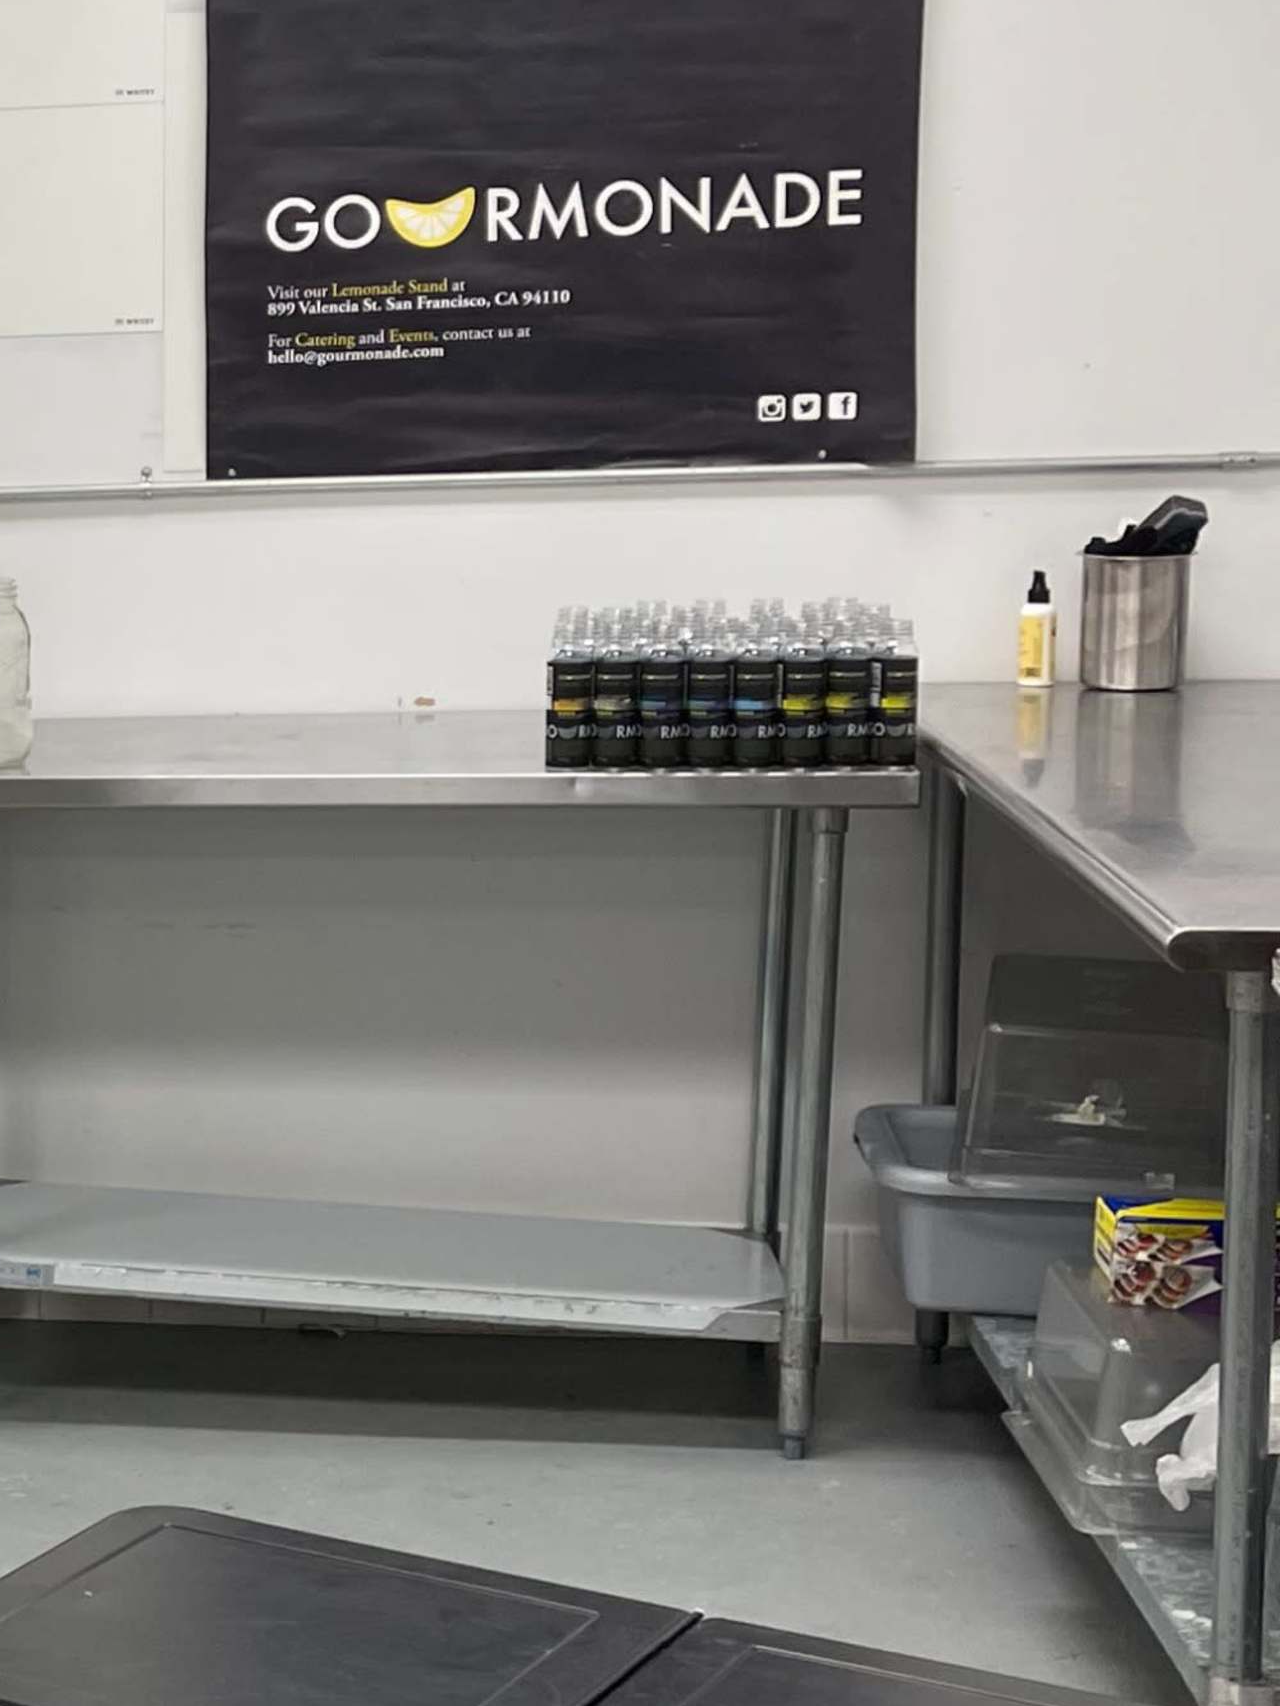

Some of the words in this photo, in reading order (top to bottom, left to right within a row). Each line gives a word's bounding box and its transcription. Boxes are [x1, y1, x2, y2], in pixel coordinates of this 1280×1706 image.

[267, 284, 300, 300] Visit
[304, 287, 328, 299] our
[331, 280, 405, 298] Lemonade
[408, 277, 449, 294] Stand
[452, 280, 466, 293] at
[266, 301, 295, 316] 899
[298, 299, 360, 315] Valencia
[362, 298, 383, 313] St.
[385, 296, 413, 312] San
[416, 293, 492, 311] Francisco,
[494, 291, 519, 306] CA
[522, 289, 571, 307] 94110
[268, 333, 293, 349] For
[295, 331, 356, 349] Catering
[358, 329, 385, 346] and
[442, 327, 494, 342] contact
[497, 328, 514, 340] us
[516, 326, 531, 339] at
[267, 345, 445, 367] hello@gourmonade.com
